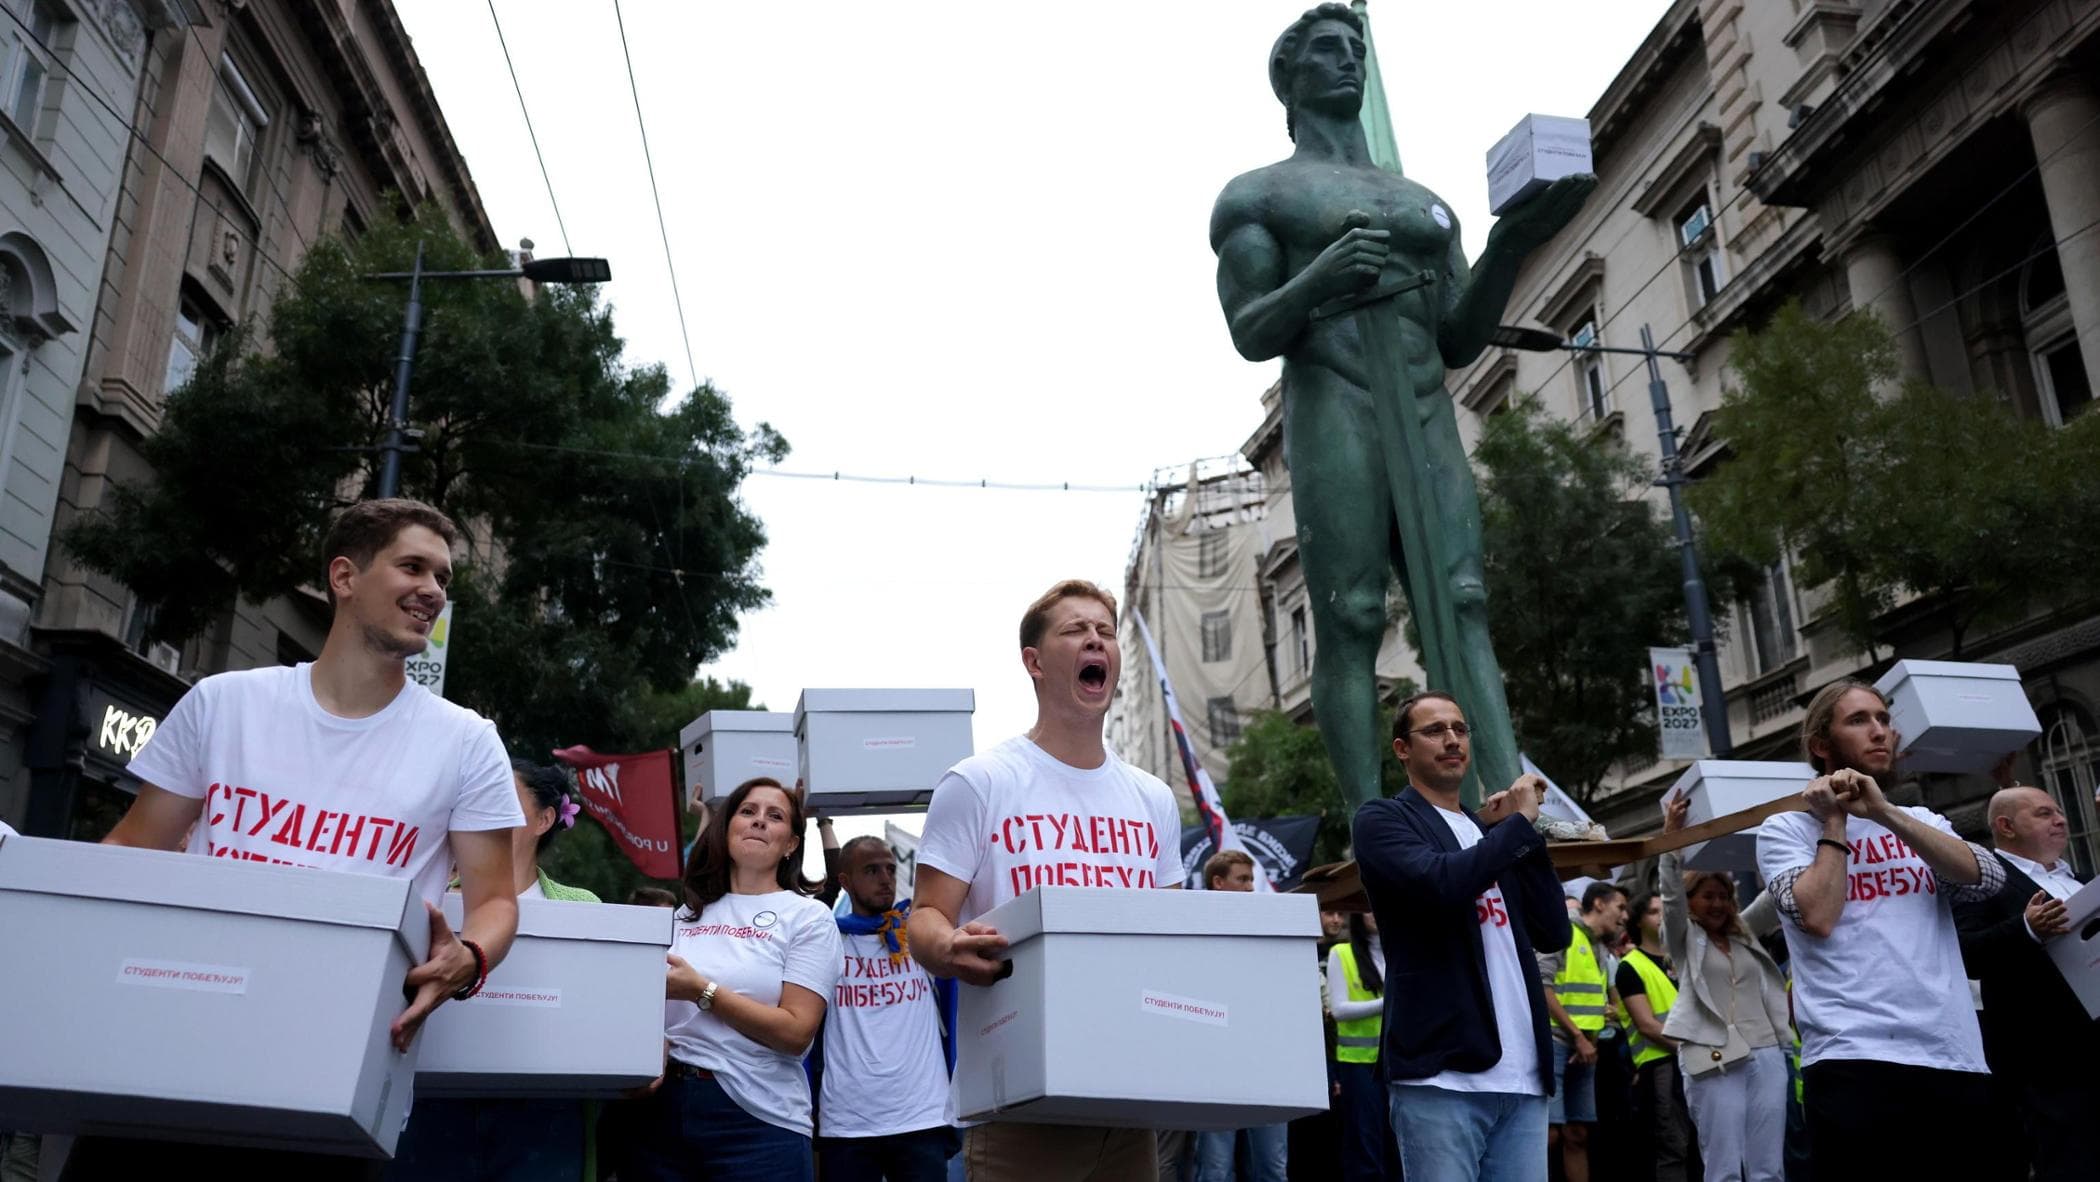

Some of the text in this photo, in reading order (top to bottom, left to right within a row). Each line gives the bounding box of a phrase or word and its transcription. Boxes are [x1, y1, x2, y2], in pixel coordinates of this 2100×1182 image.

[405, 661, 442, 673] XPO
[1662, 706, 1698, 718] EXPO
[1663, 718, 1698, 729] 2027
[207, 783, 419, 868] СТУДЕНТИ
[124, 965, 180, 979] СТУДЕНТИ
[476, 991, 514, 999] СТУДЕНТИ
[1144, 996, 1183, 1010] СТУДЕНТИ
